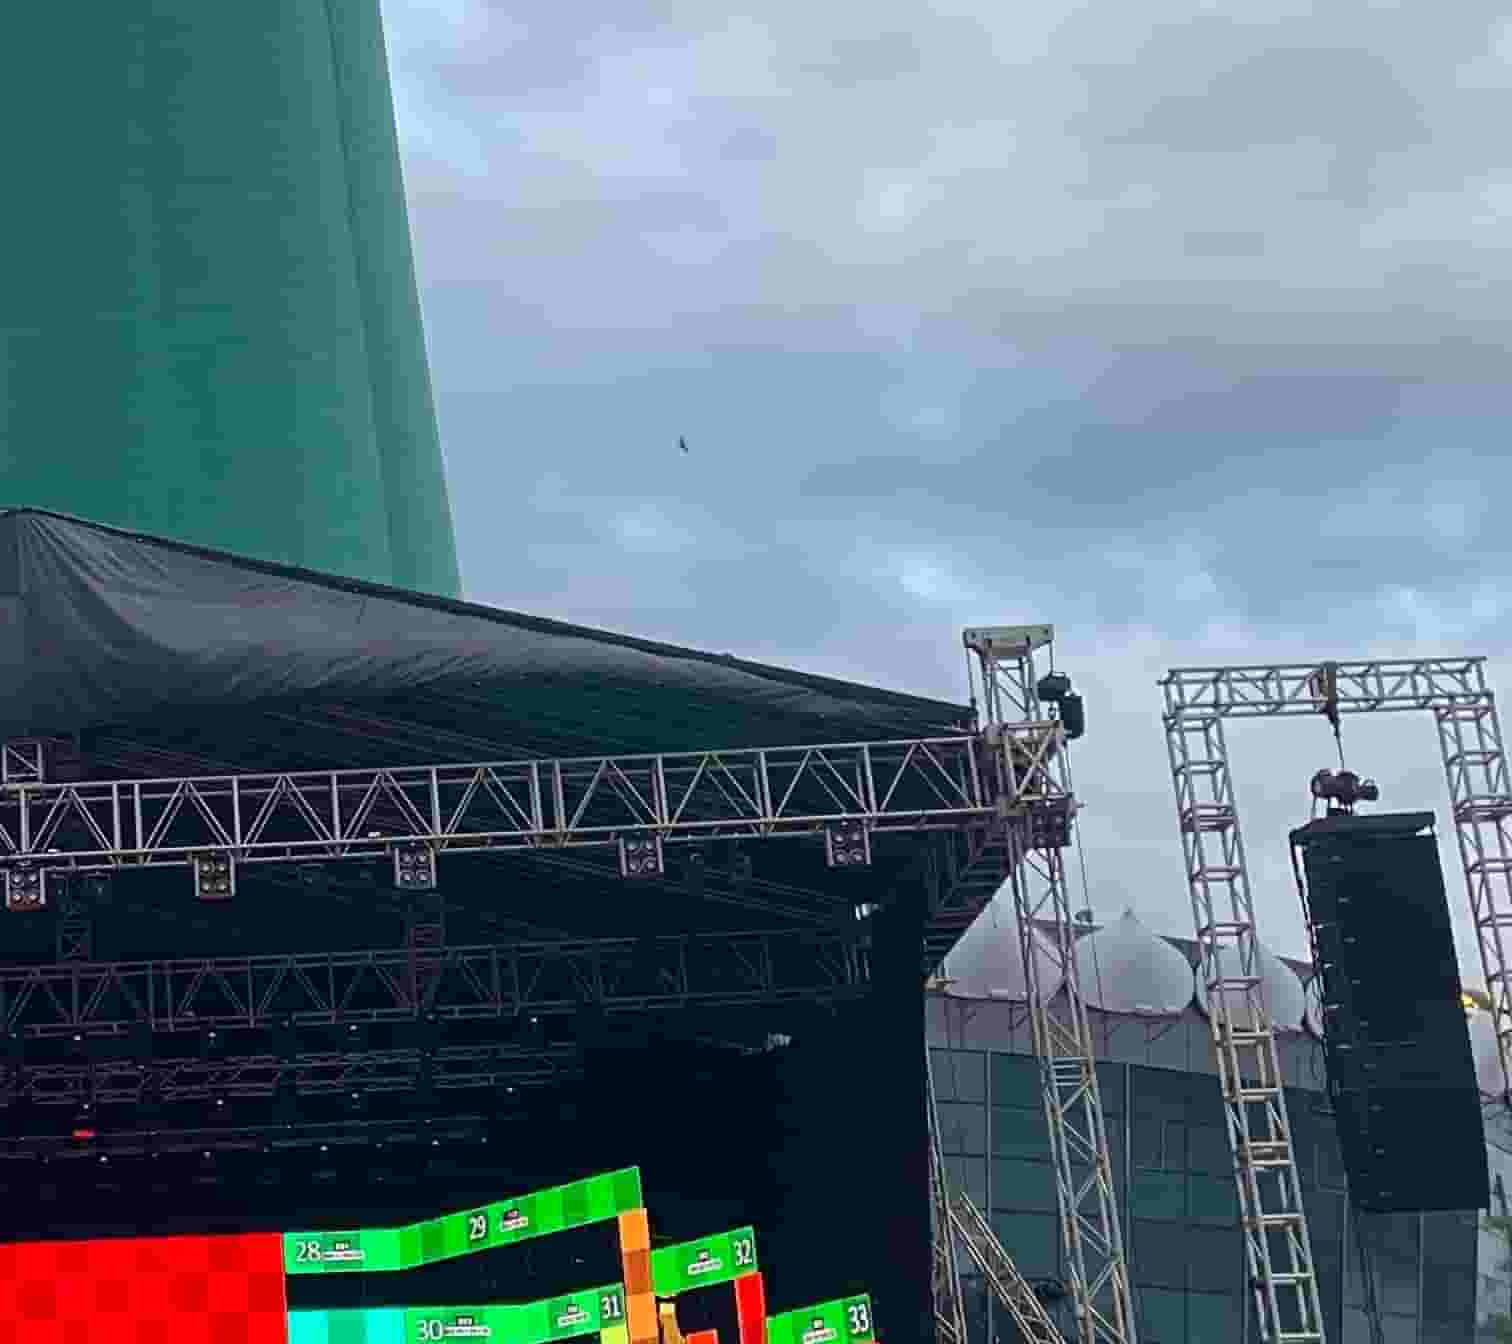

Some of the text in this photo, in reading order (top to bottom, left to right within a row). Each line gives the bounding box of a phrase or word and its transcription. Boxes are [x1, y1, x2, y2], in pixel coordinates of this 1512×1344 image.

[469, 1216, 487, 1240] 29
[295, 1242, 320, 1263] 28
[734, 1239, 754, 1267] 32
[601, 1297, 623, 1321] 31
[848, 1304, 870, 1335] 33
[416, 1321, 443, 1342] 30
